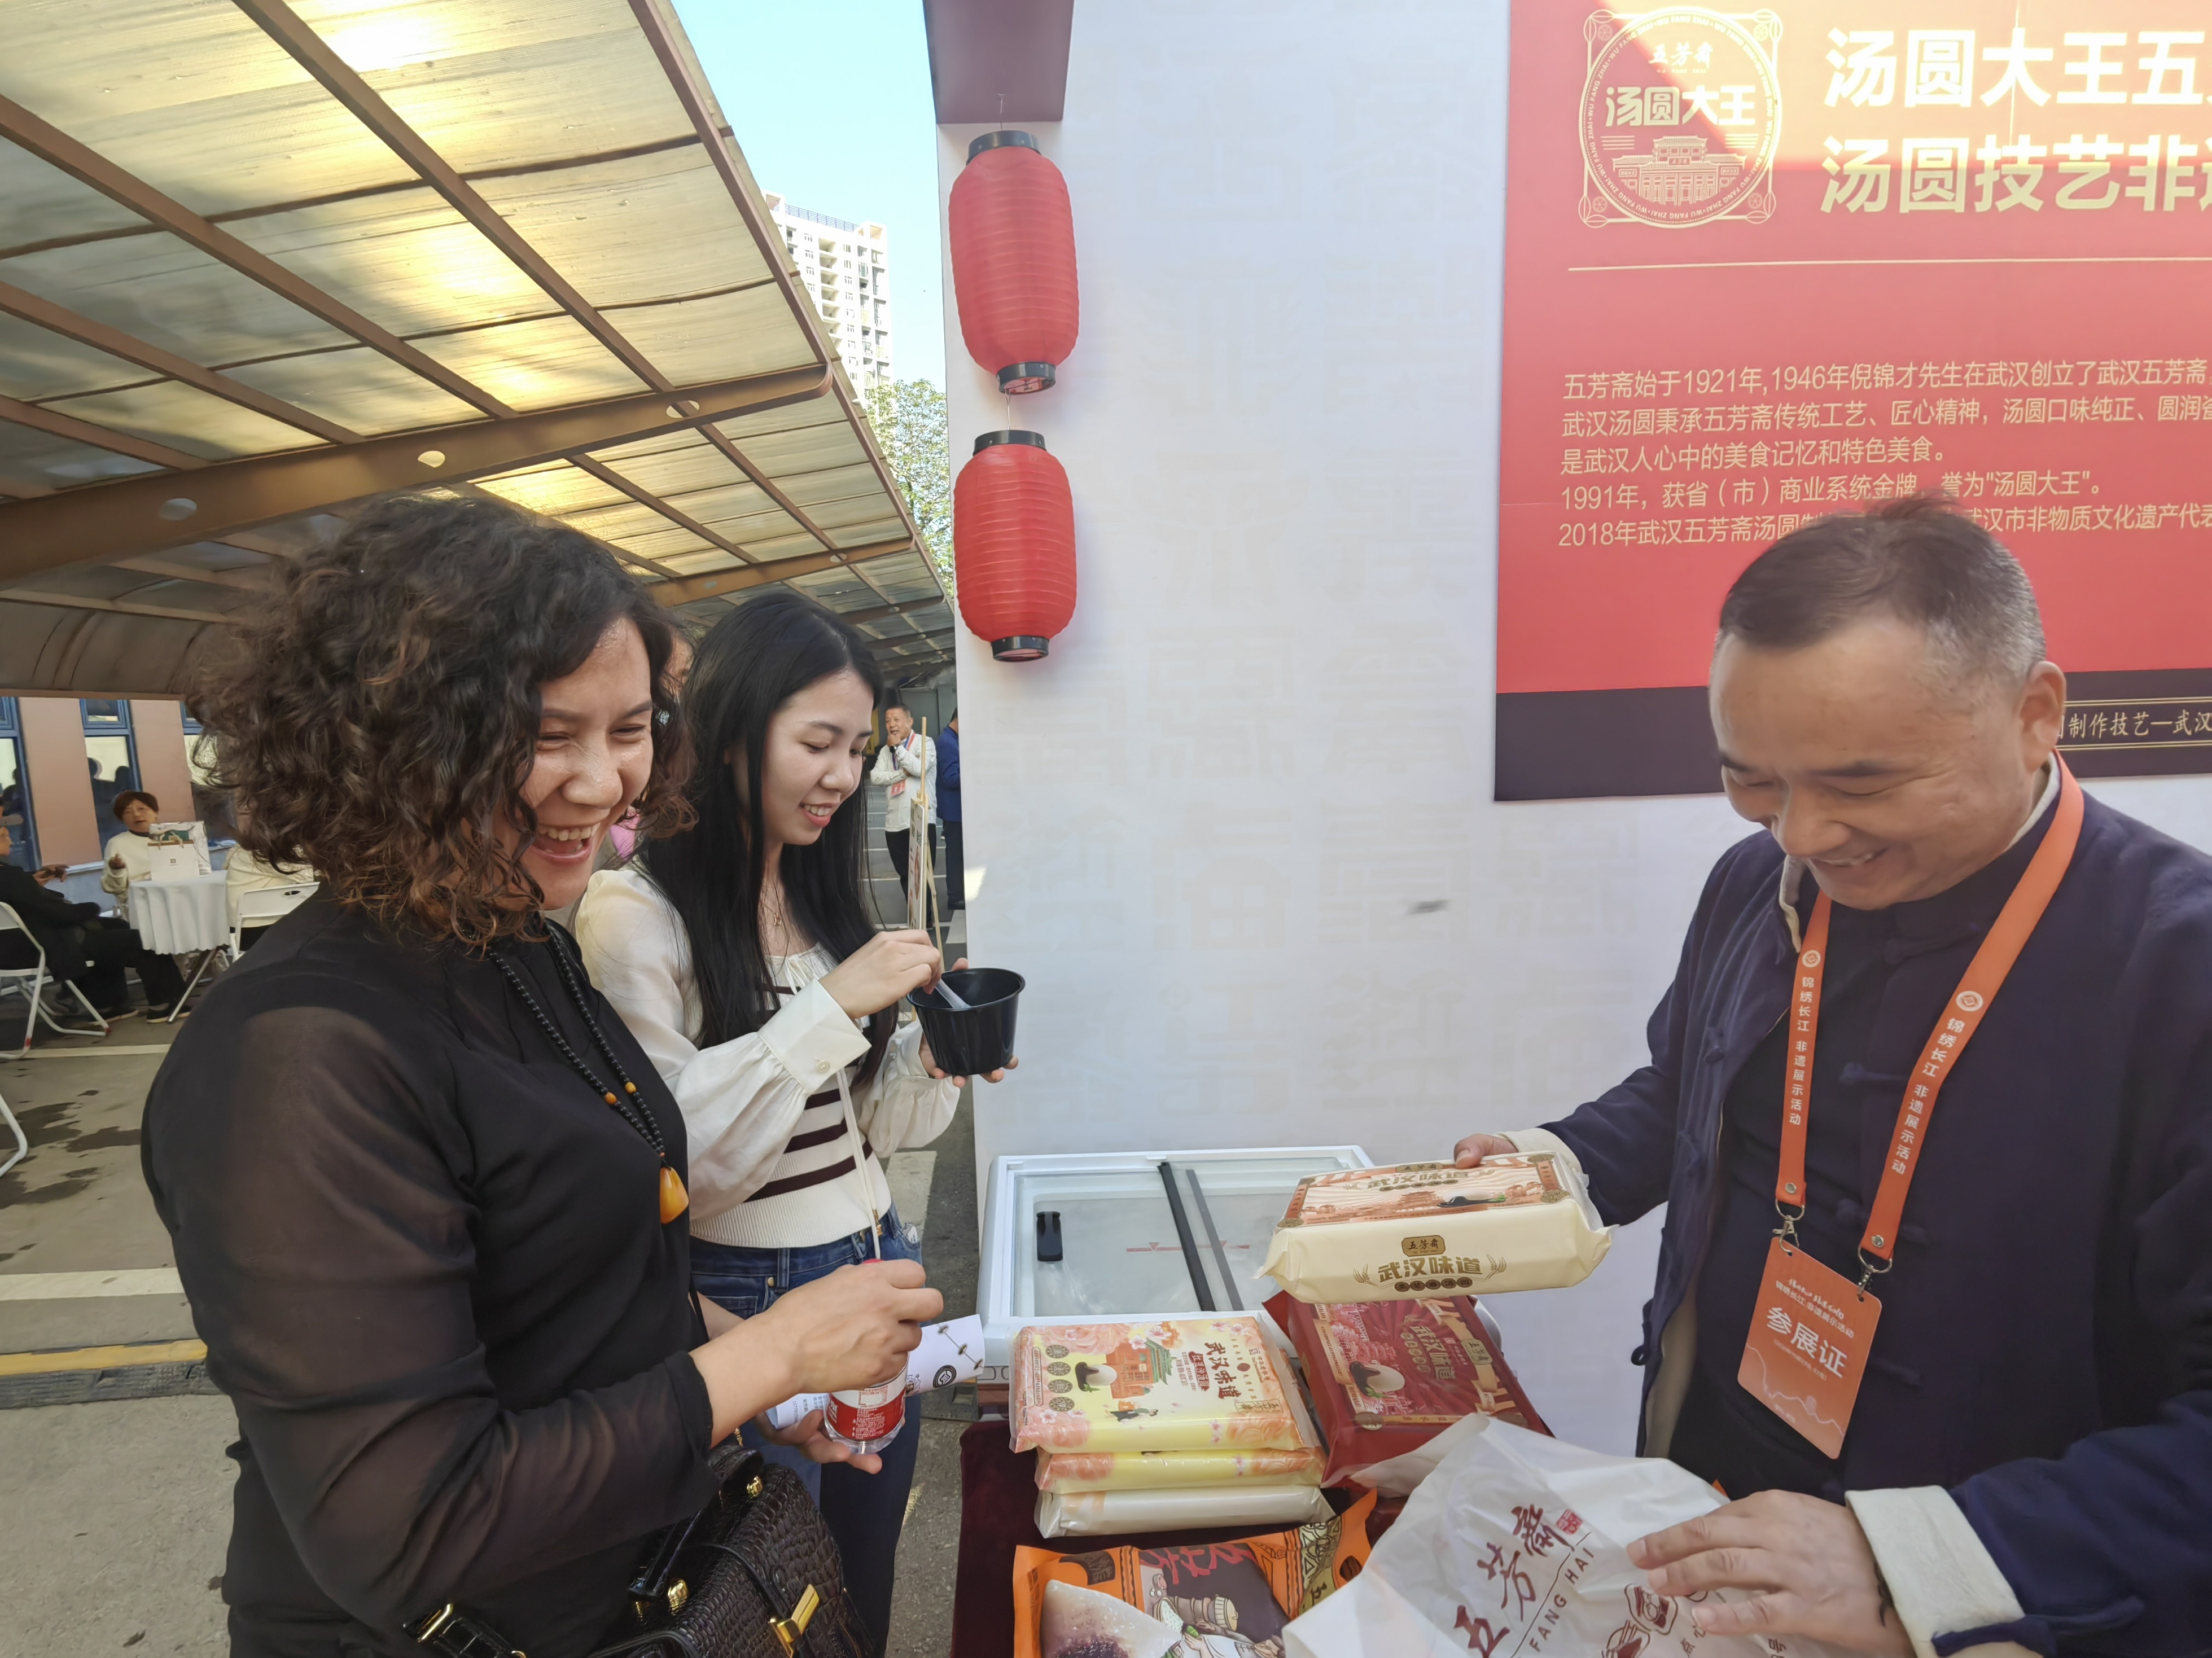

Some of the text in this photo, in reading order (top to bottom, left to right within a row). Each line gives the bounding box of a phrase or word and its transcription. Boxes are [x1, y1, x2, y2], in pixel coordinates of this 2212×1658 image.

[1825, 27, 2212, 107] 汤圆大王五
[1605, 85, 1756, 127] 汤圆大王
[1819, 133, 2212, 214] 汤圆技艺非
[2059, 709, 2212, 739] 制作技艺—武汉
[1789, 976, 1815, 1126] 锦绣长江 非遗展示活动
[1891, 1017, 1965, 1175] 锦绣长江 非遗展示活动
[1367, 1172, 1469, 1189] 武汉味道
[1378, 1256, 1483, 1283] 武汉味道
[1204, 1341, 1242, 1400] 武汉味道
[1409, 1326, 1456, 1380] 武汉味道
[1767, 1306, 1847, 1379] 参展证
[1528, 1593, 1567, 1652] FANG
[1564, 1547, 1595, 1585] HAI
